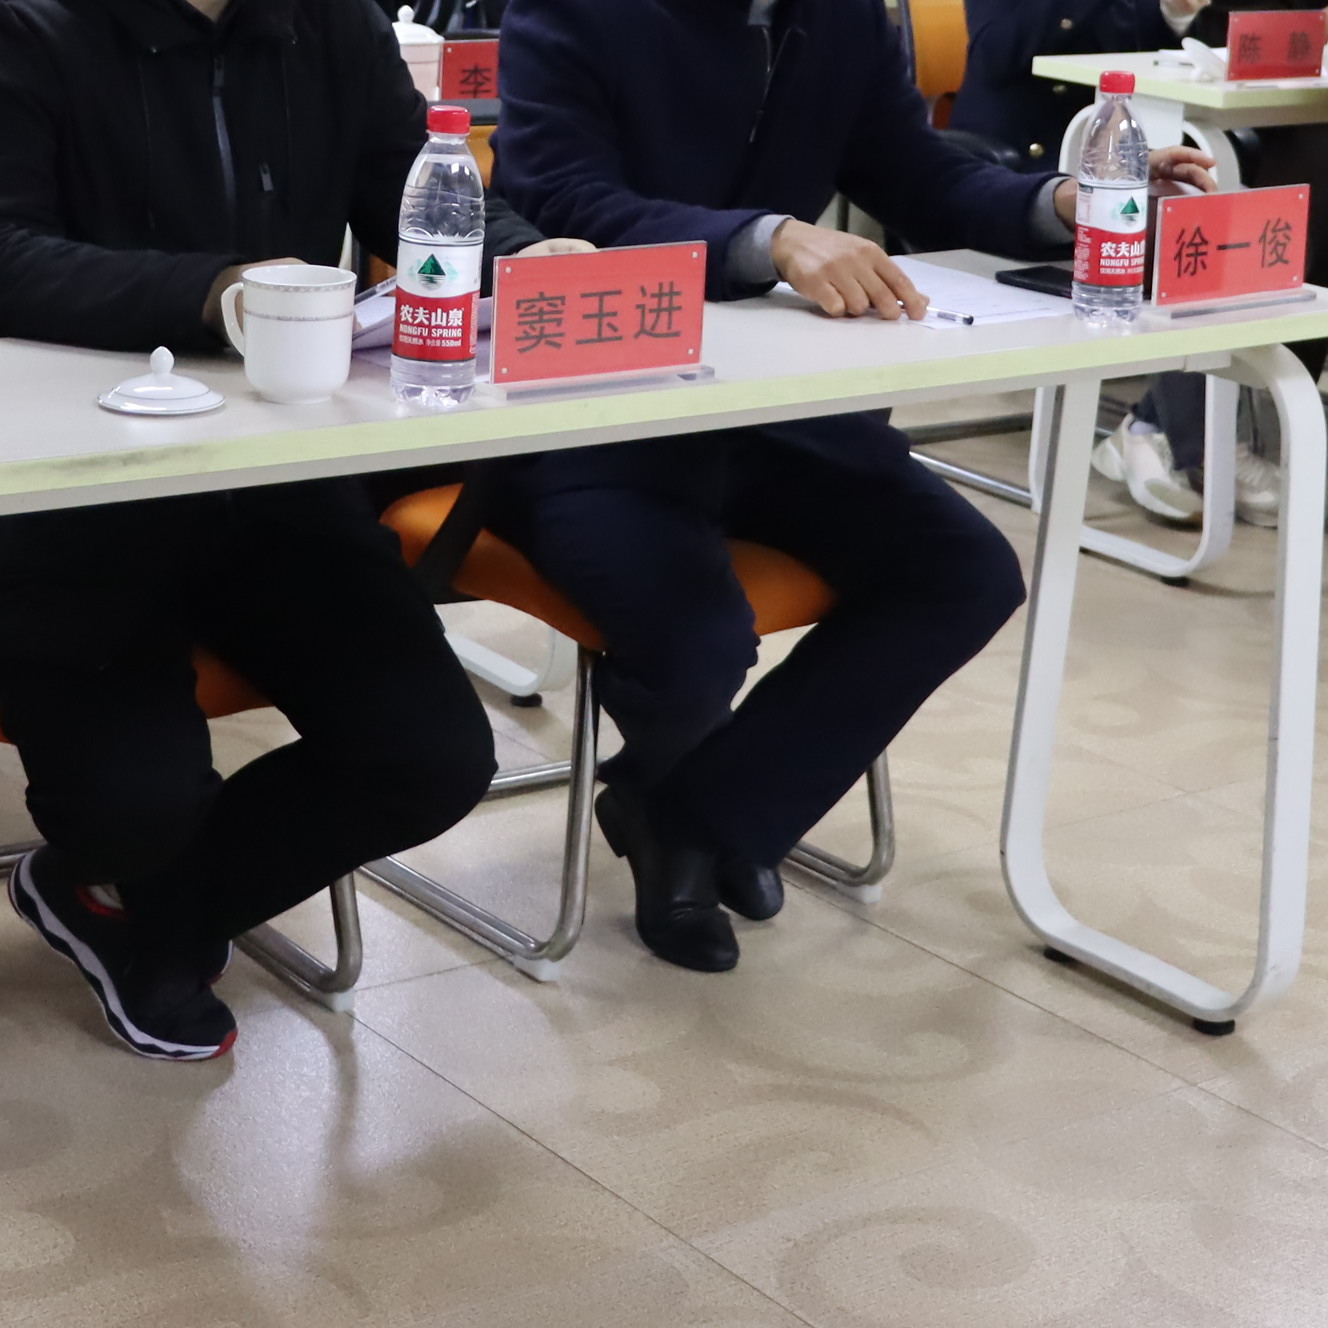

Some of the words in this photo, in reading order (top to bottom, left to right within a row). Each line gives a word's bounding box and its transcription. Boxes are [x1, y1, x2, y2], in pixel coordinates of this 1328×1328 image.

[459, 63, 491, 99] 李
[1174, 218, 1293, 278] 徐一俊
[399, 304, 463, 327] 农夫山泉
[399, 323, 428, 337] NONGFU
[431, 328, 462, 338] SPRING
[514, 280, 683, 354] 窦玉进
